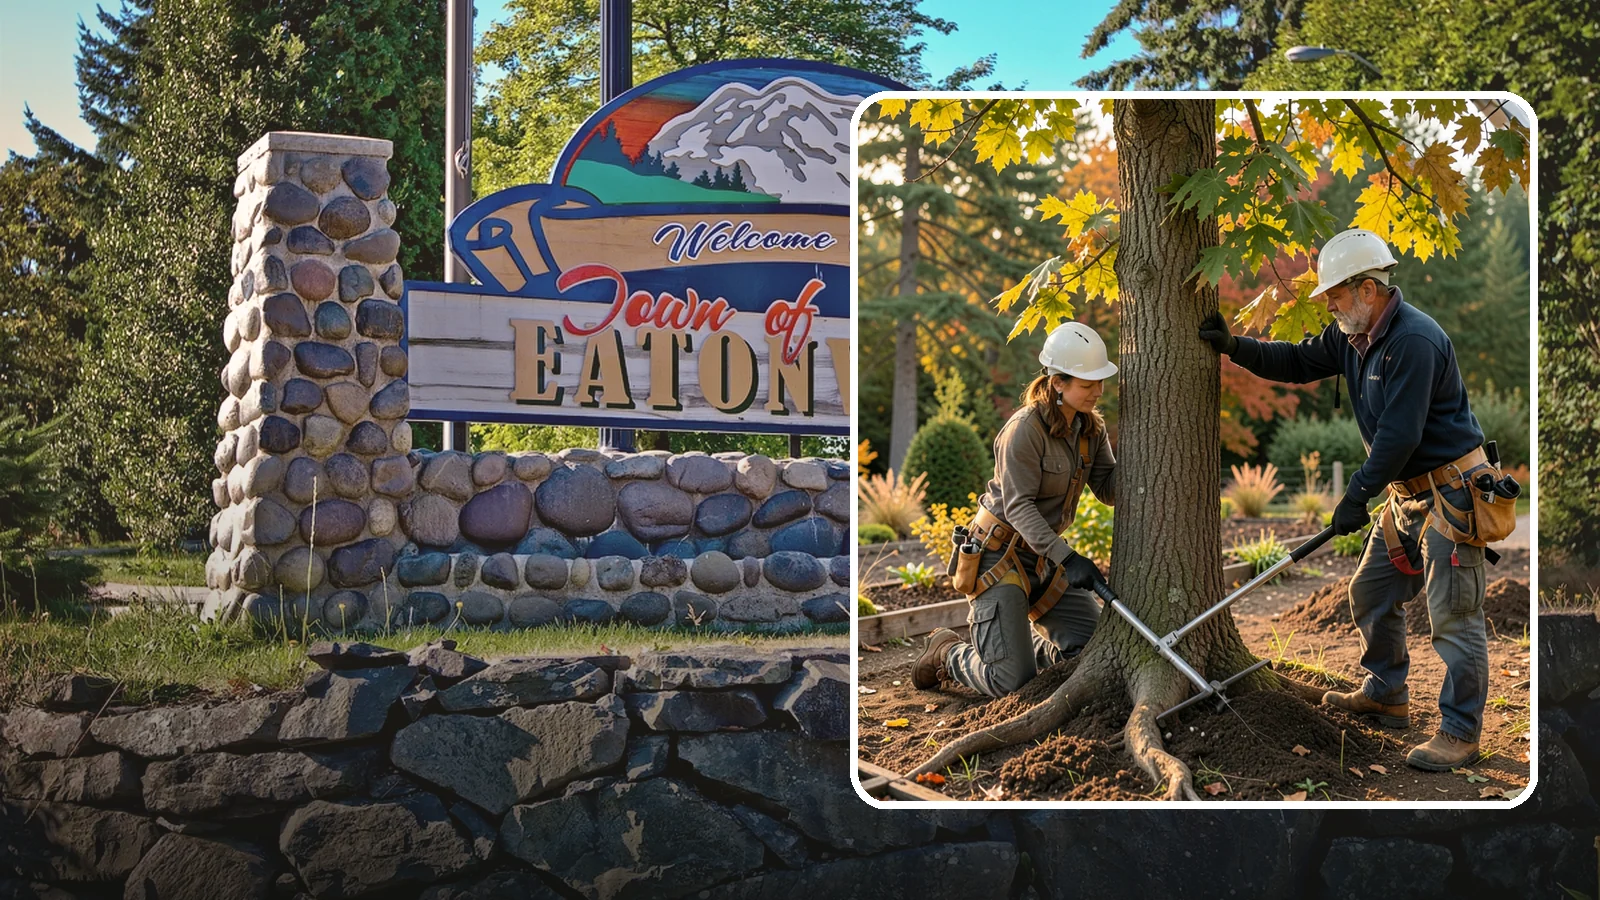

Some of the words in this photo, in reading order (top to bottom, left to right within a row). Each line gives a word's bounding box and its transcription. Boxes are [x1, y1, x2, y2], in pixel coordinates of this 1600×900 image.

[653, 220, 837, 263] Welcome
[557, 263, 737, 336] Town
[765, 278, 826, 366] of
